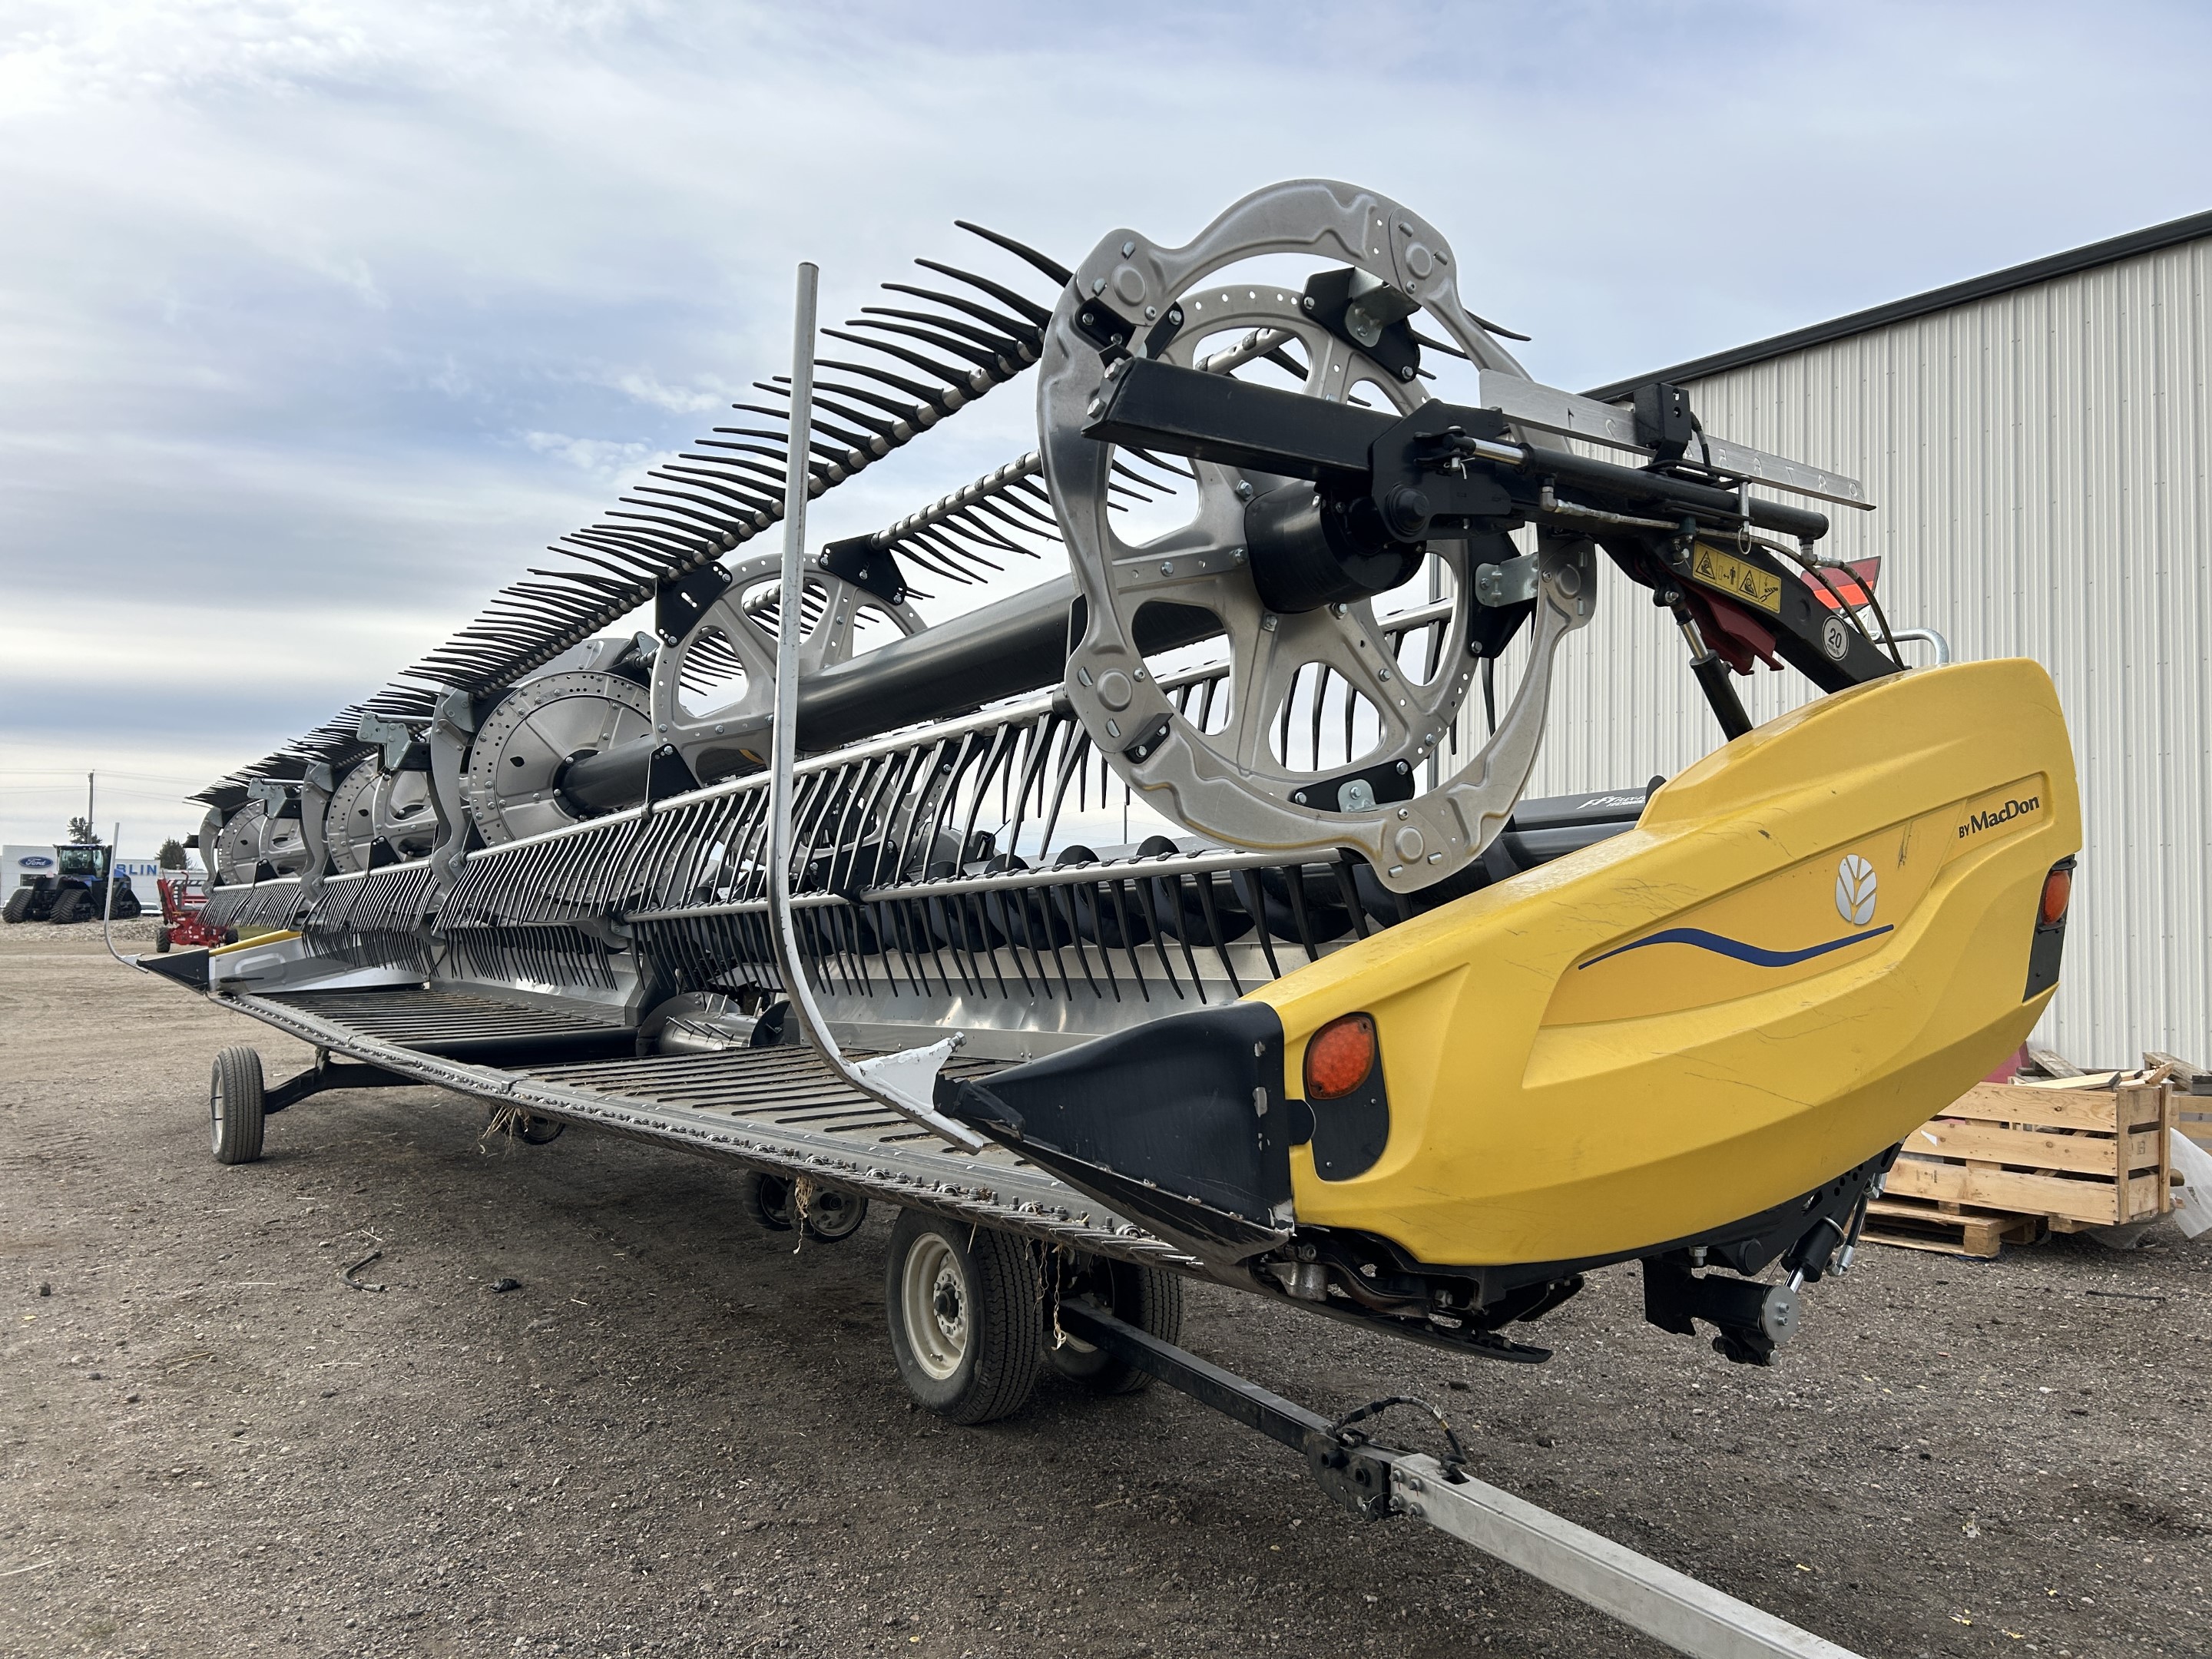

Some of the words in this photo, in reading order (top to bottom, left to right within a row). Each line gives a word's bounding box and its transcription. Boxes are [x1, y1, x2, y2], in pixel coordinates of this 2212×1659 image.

[1828, 628, 1842, 648] 20
[1959, 823, 1970, 839] BY
[1970, 796, 2040, 834] MacDon
[25, 858, 47, 866] Ford
